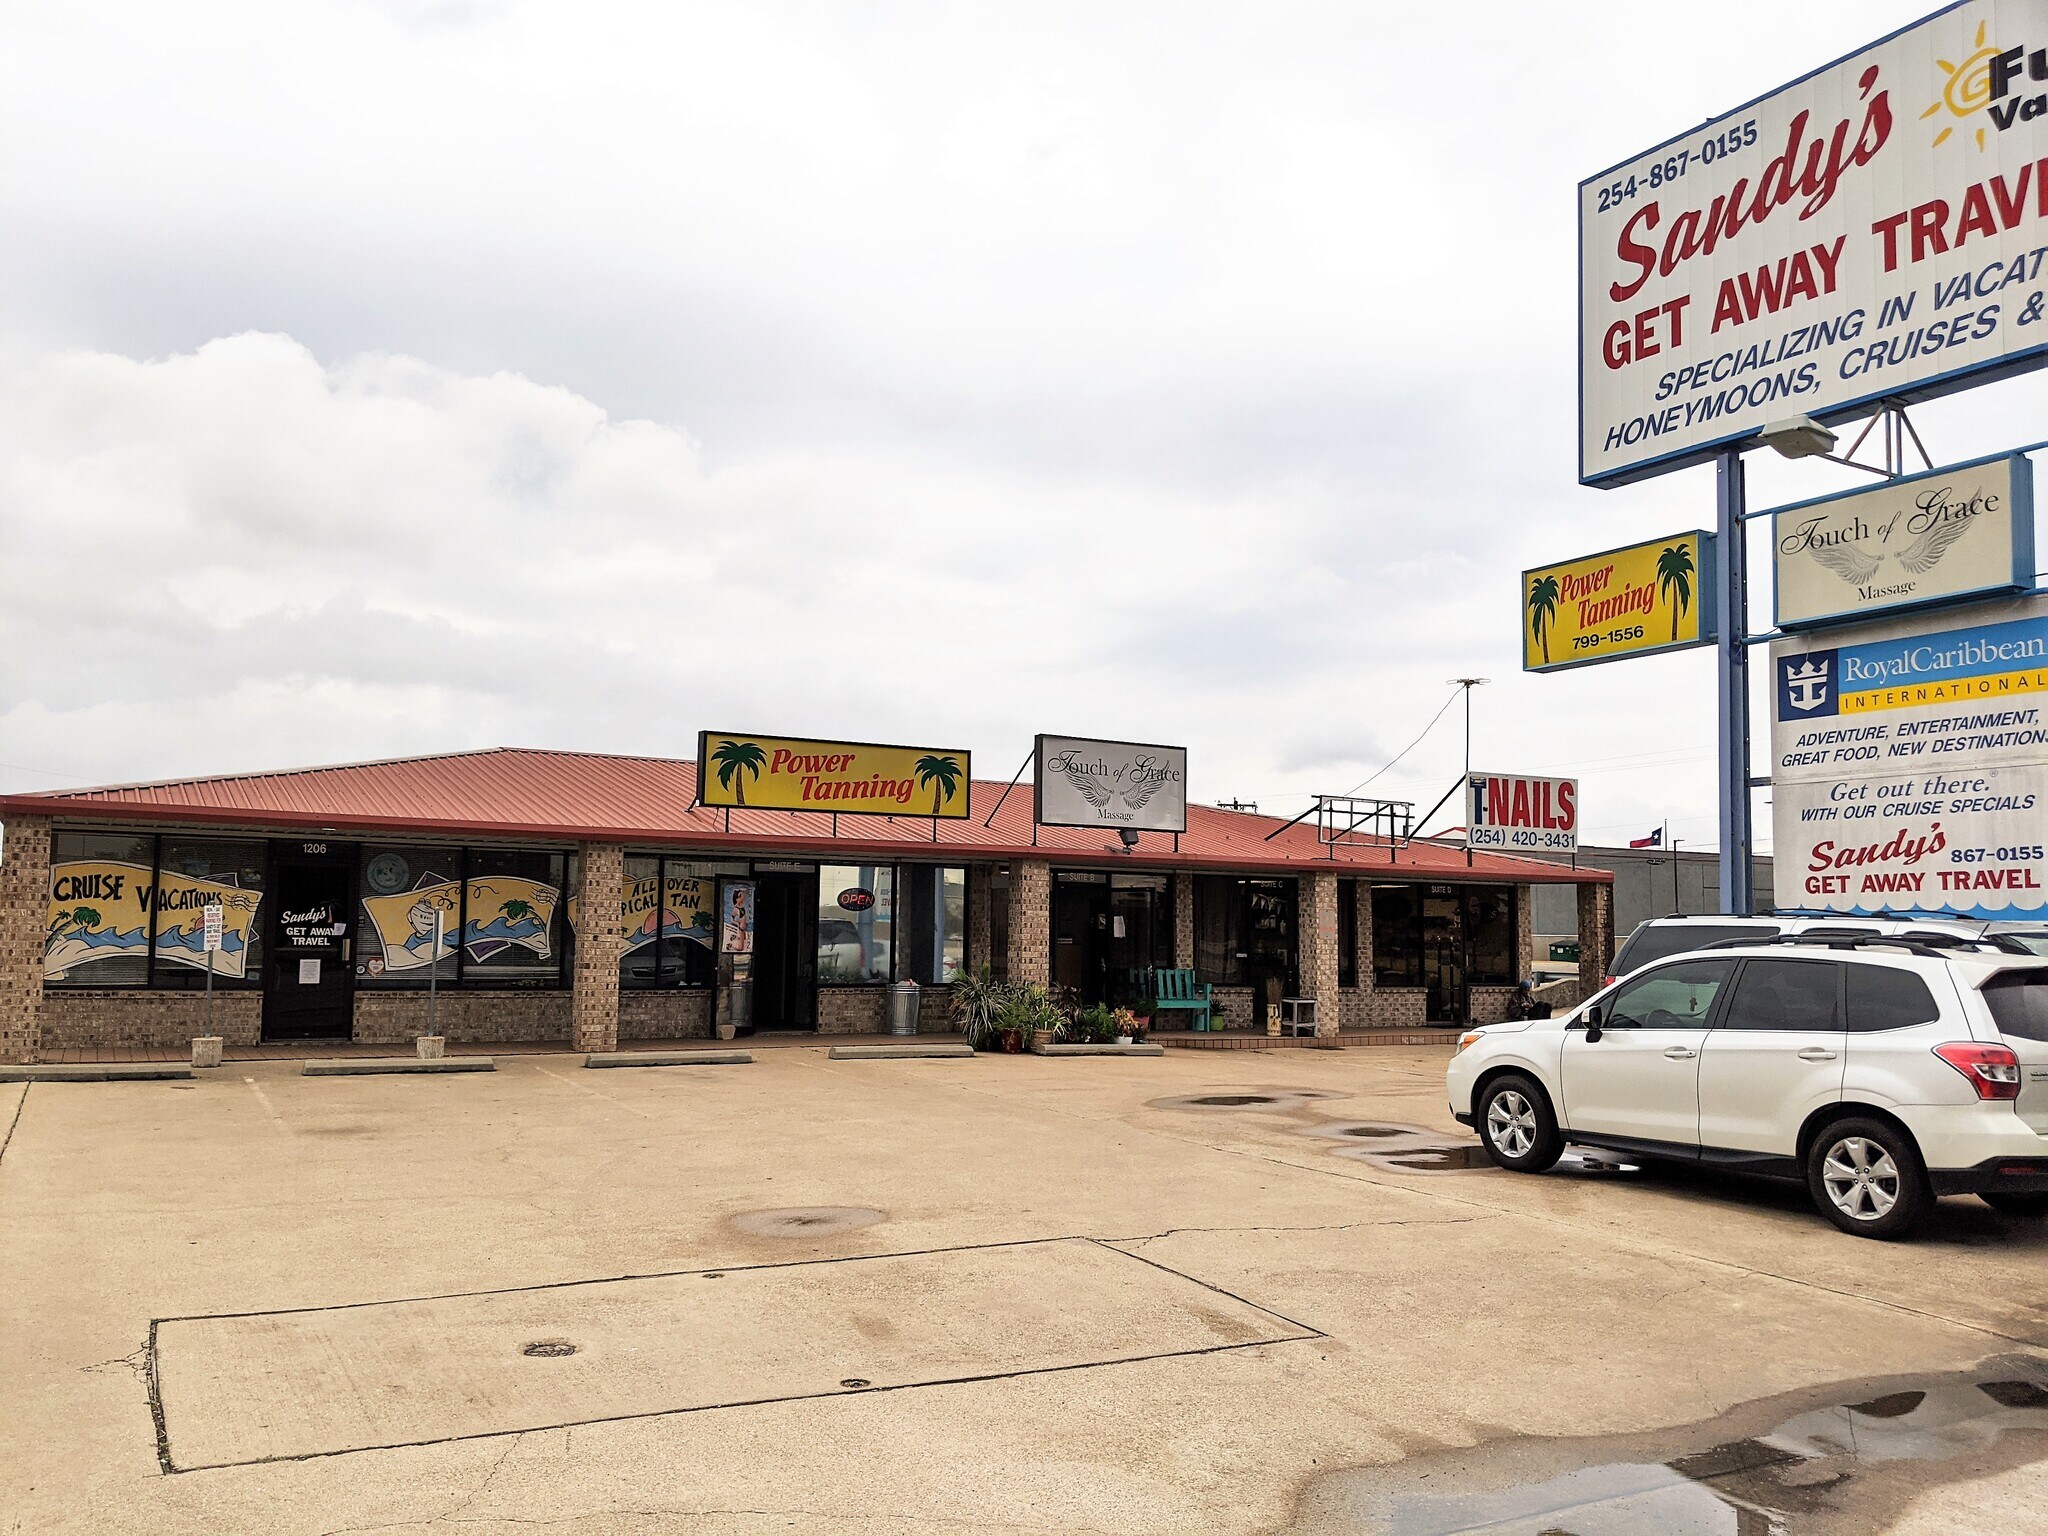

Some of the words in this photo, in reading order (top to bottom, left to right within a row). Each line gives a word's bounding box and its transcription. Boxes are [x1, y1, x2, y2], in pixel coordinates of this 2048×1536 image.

[1597, 119, 1758, 213] 254-867-0155
[1609, 65, 1892, 302] Sandy's
[1602, 294, 1690, 370] GET
[1711, 234, 1847, 334] AWAY
[1655, 308, 1865, 401] SPECIALIZING
[1877, 291, 1916, 329] IN
[1603, 362, 1821, 452] HONEYMOONS,
[1839, 304, 2000, 380] CRUISES
[2017, 290, 2044, 326] &
[1780, 515, 1869, 555] Touch
[1877, 511, 1902, 543] of
[1907, 486, 2000, 535] Grace
[1560, 564, 1614, 605] Power
[1858, 581, 1916, 602] Massage
[1578, 581, 1656, 630] Tanning
[1572, 625, 1645, 650] 799-1556
[1845, 674, 2046, 709] INTERNATIONAL
[1796, 725, 1889, 748] ADVENTURE,
[1896, 709, 2040, 738] ENTERTAINMENT,
[771, 748, 855, 774] Power
[1047, 750, 1108, 776] Touch
[1113, 762, 1129, 783] of
[1130, 754, 1180, 783] Grace
[1781, 750, 1830, 768] GREAT
[1833, 746, 1881, 763] FOOD,
[1887, 740, 1928, 757] NEW
[800, 773, 915, 804] Tanning
[1830, 782, 1869, 801] Get
[1876, 779, 1914, 798] out
[1923, 775, 1991, 796] there.
[1097, 808, 1134, 823] Massage
[1801, 807, 1839, 822] WITH
[1843, 804, 1877, 819] OUR
[1882, 801, 1944, 817] CRUISE
[1949, 794, 2036, 814] SPECIALS
[302, 843, 327, 854] 1206
[1470, 827, 1506, 846] (254)
[1511, 831, 1575, 848] 420-3431
[1808, 822, 1947, 872] Sandy's
[769, 861, 792, 871] SUITE
[1950, 846, 2044, 863] 867-0155
[53, 873, 126, 902] CRUISE
[631, 880, 657, 898] ALL
[1069, 872, 1088, 881] SUITE
[1431, 885, 1446, 894] SUITE
[1804, 875, 1850, 894] GET
[1860, 872, 1926, 893] AWAY
[1937, 868, 2041, 891] TRAVEL
[621, 894, 658, 917] PICAL
[670, 893, 701, 910] TAN
[840, 893, 874, 905] OPEN
[280, 906, 326, 924] Sandy's
[286, 927, 307, 936] GET
[310, 927, 335, 936] AWAY
[291, 937, 331, 946] TRAVEL
